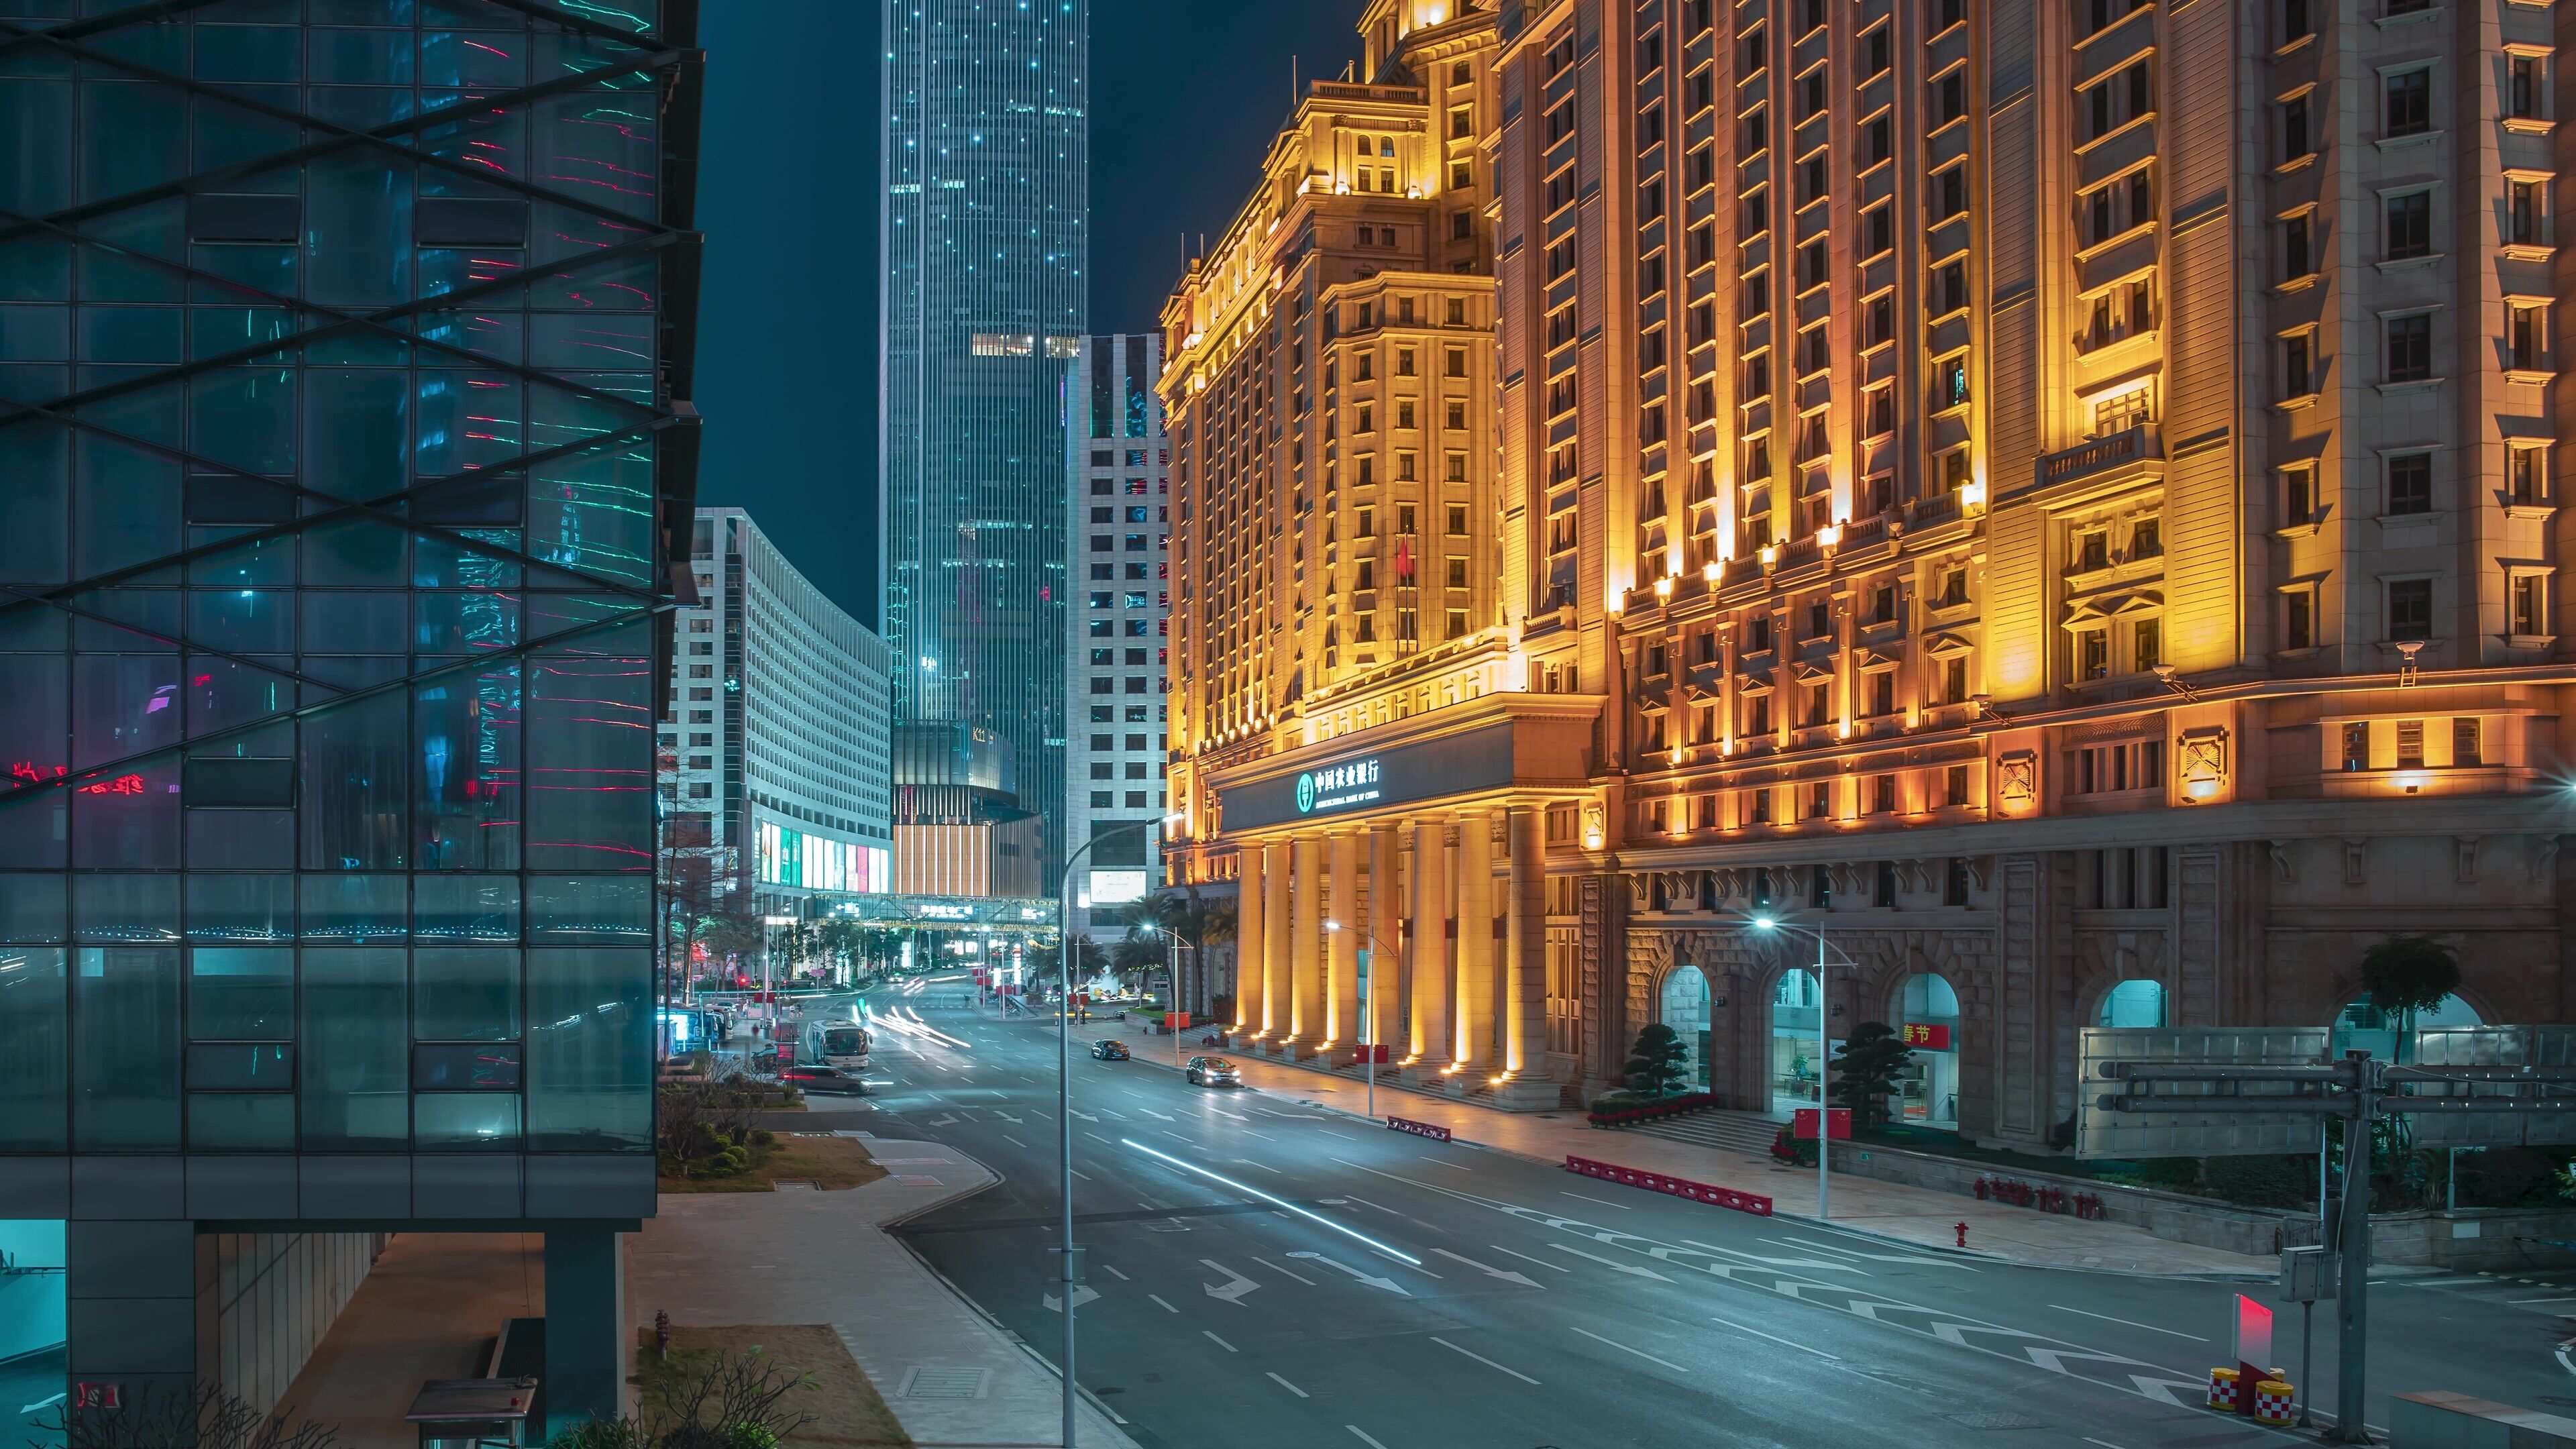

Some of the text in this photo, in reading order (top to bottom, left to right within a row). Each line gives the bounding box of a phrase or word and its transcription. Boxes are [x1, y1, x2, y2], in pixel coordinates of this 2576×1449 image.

[973, 727, 985, 743] K11
[1315, 759, 1379, 793] 中国农业银行
[1904, 1024, 1930, 1043] 春节
